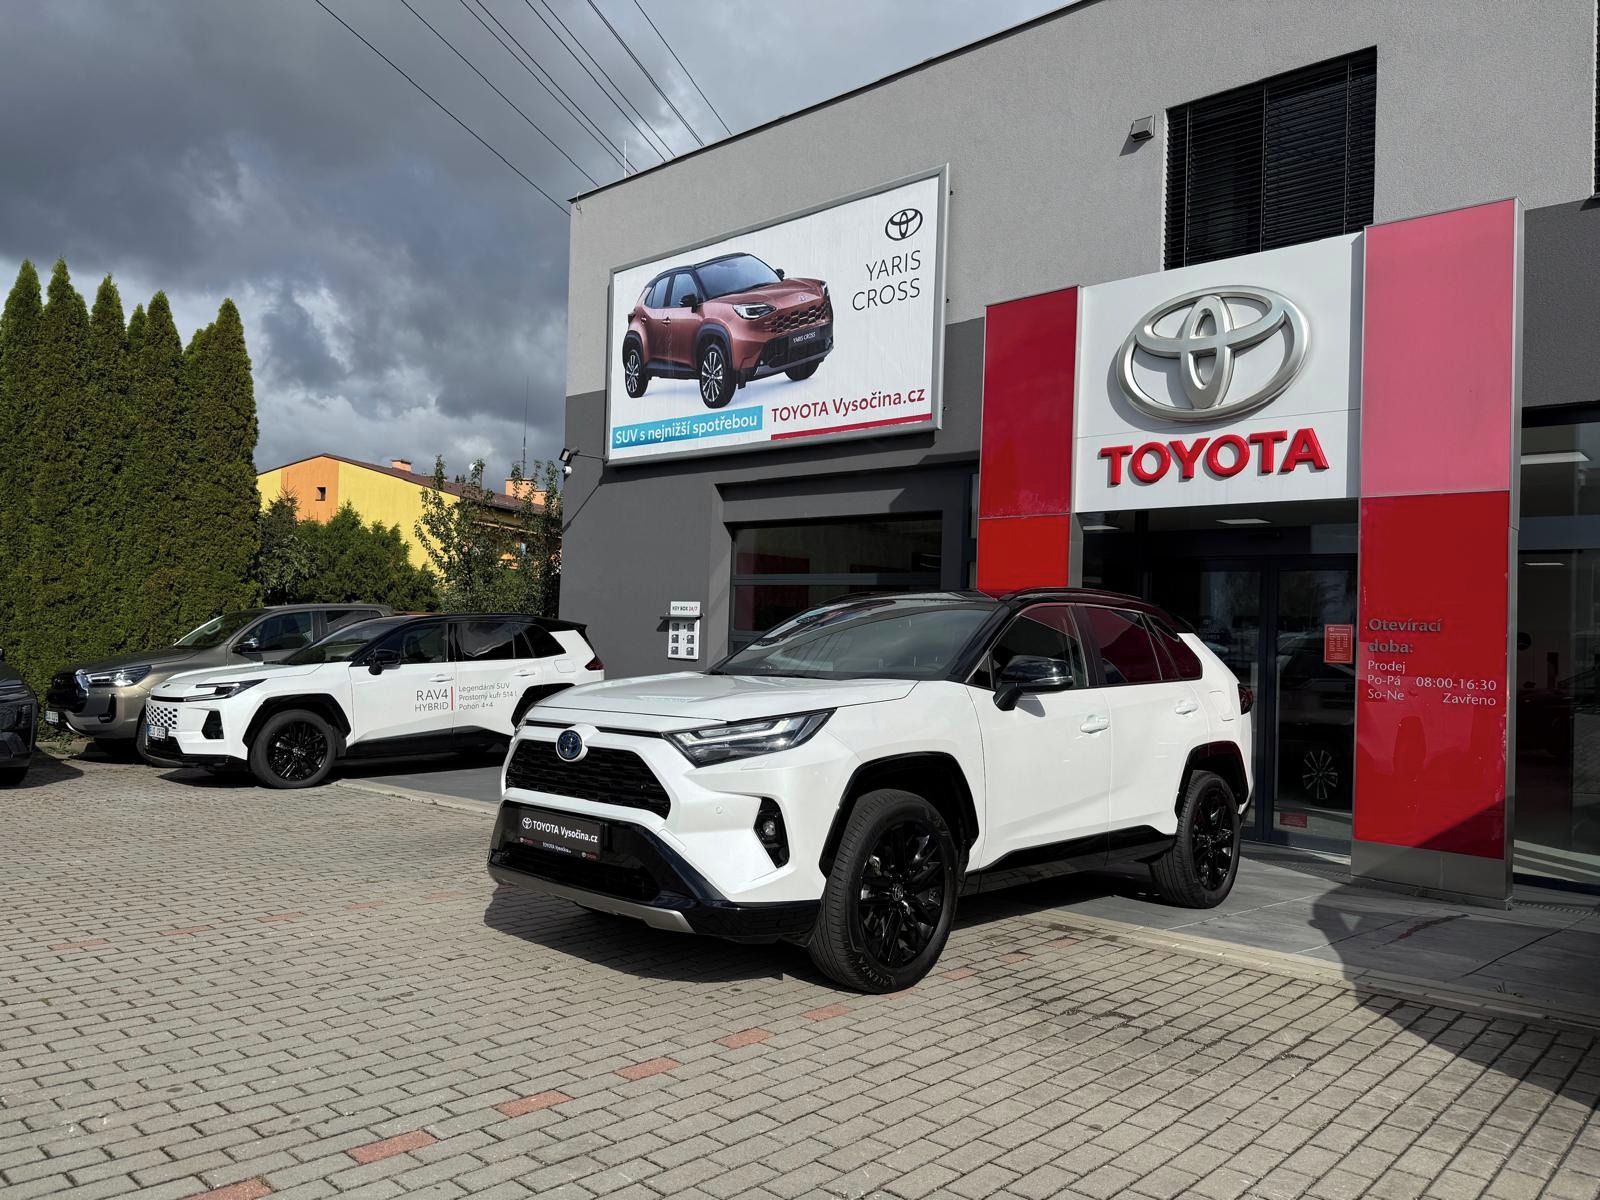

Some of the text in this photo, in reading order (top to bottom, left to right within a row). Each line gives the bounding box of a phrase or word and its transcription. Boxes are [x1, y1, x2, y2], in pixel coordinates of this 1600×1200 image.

[865, 249, 921, 281] YARIS
[852, 277, 920, 311] CROSS
[771, 388, 926, 423] TOYOTA Vysočina.cz
[615, 413, 758, 444] SUV s nejnižší spotřebou
[1100, 426, 1330, 486] TOYOTA
[1368, 618, 1442, 633] Otevírací
[1368, 639, 1414, 653] doba:
[1367, 660, 1406, 675] Prodej
[496, 682, 510, 690] SUV
[1367, 674, 1497, 691] Po-Pá 08:00-16:30
[416, 689, 449, 702] RAV4
[1367, 689, 1497, 706] So-Ne Zavřeno
[414, 702, 449, 713] HYBRID
[459, 703, 480, 711] Pohon
[532, 820, 599, 843] TOYOTA Vysočina.cz
